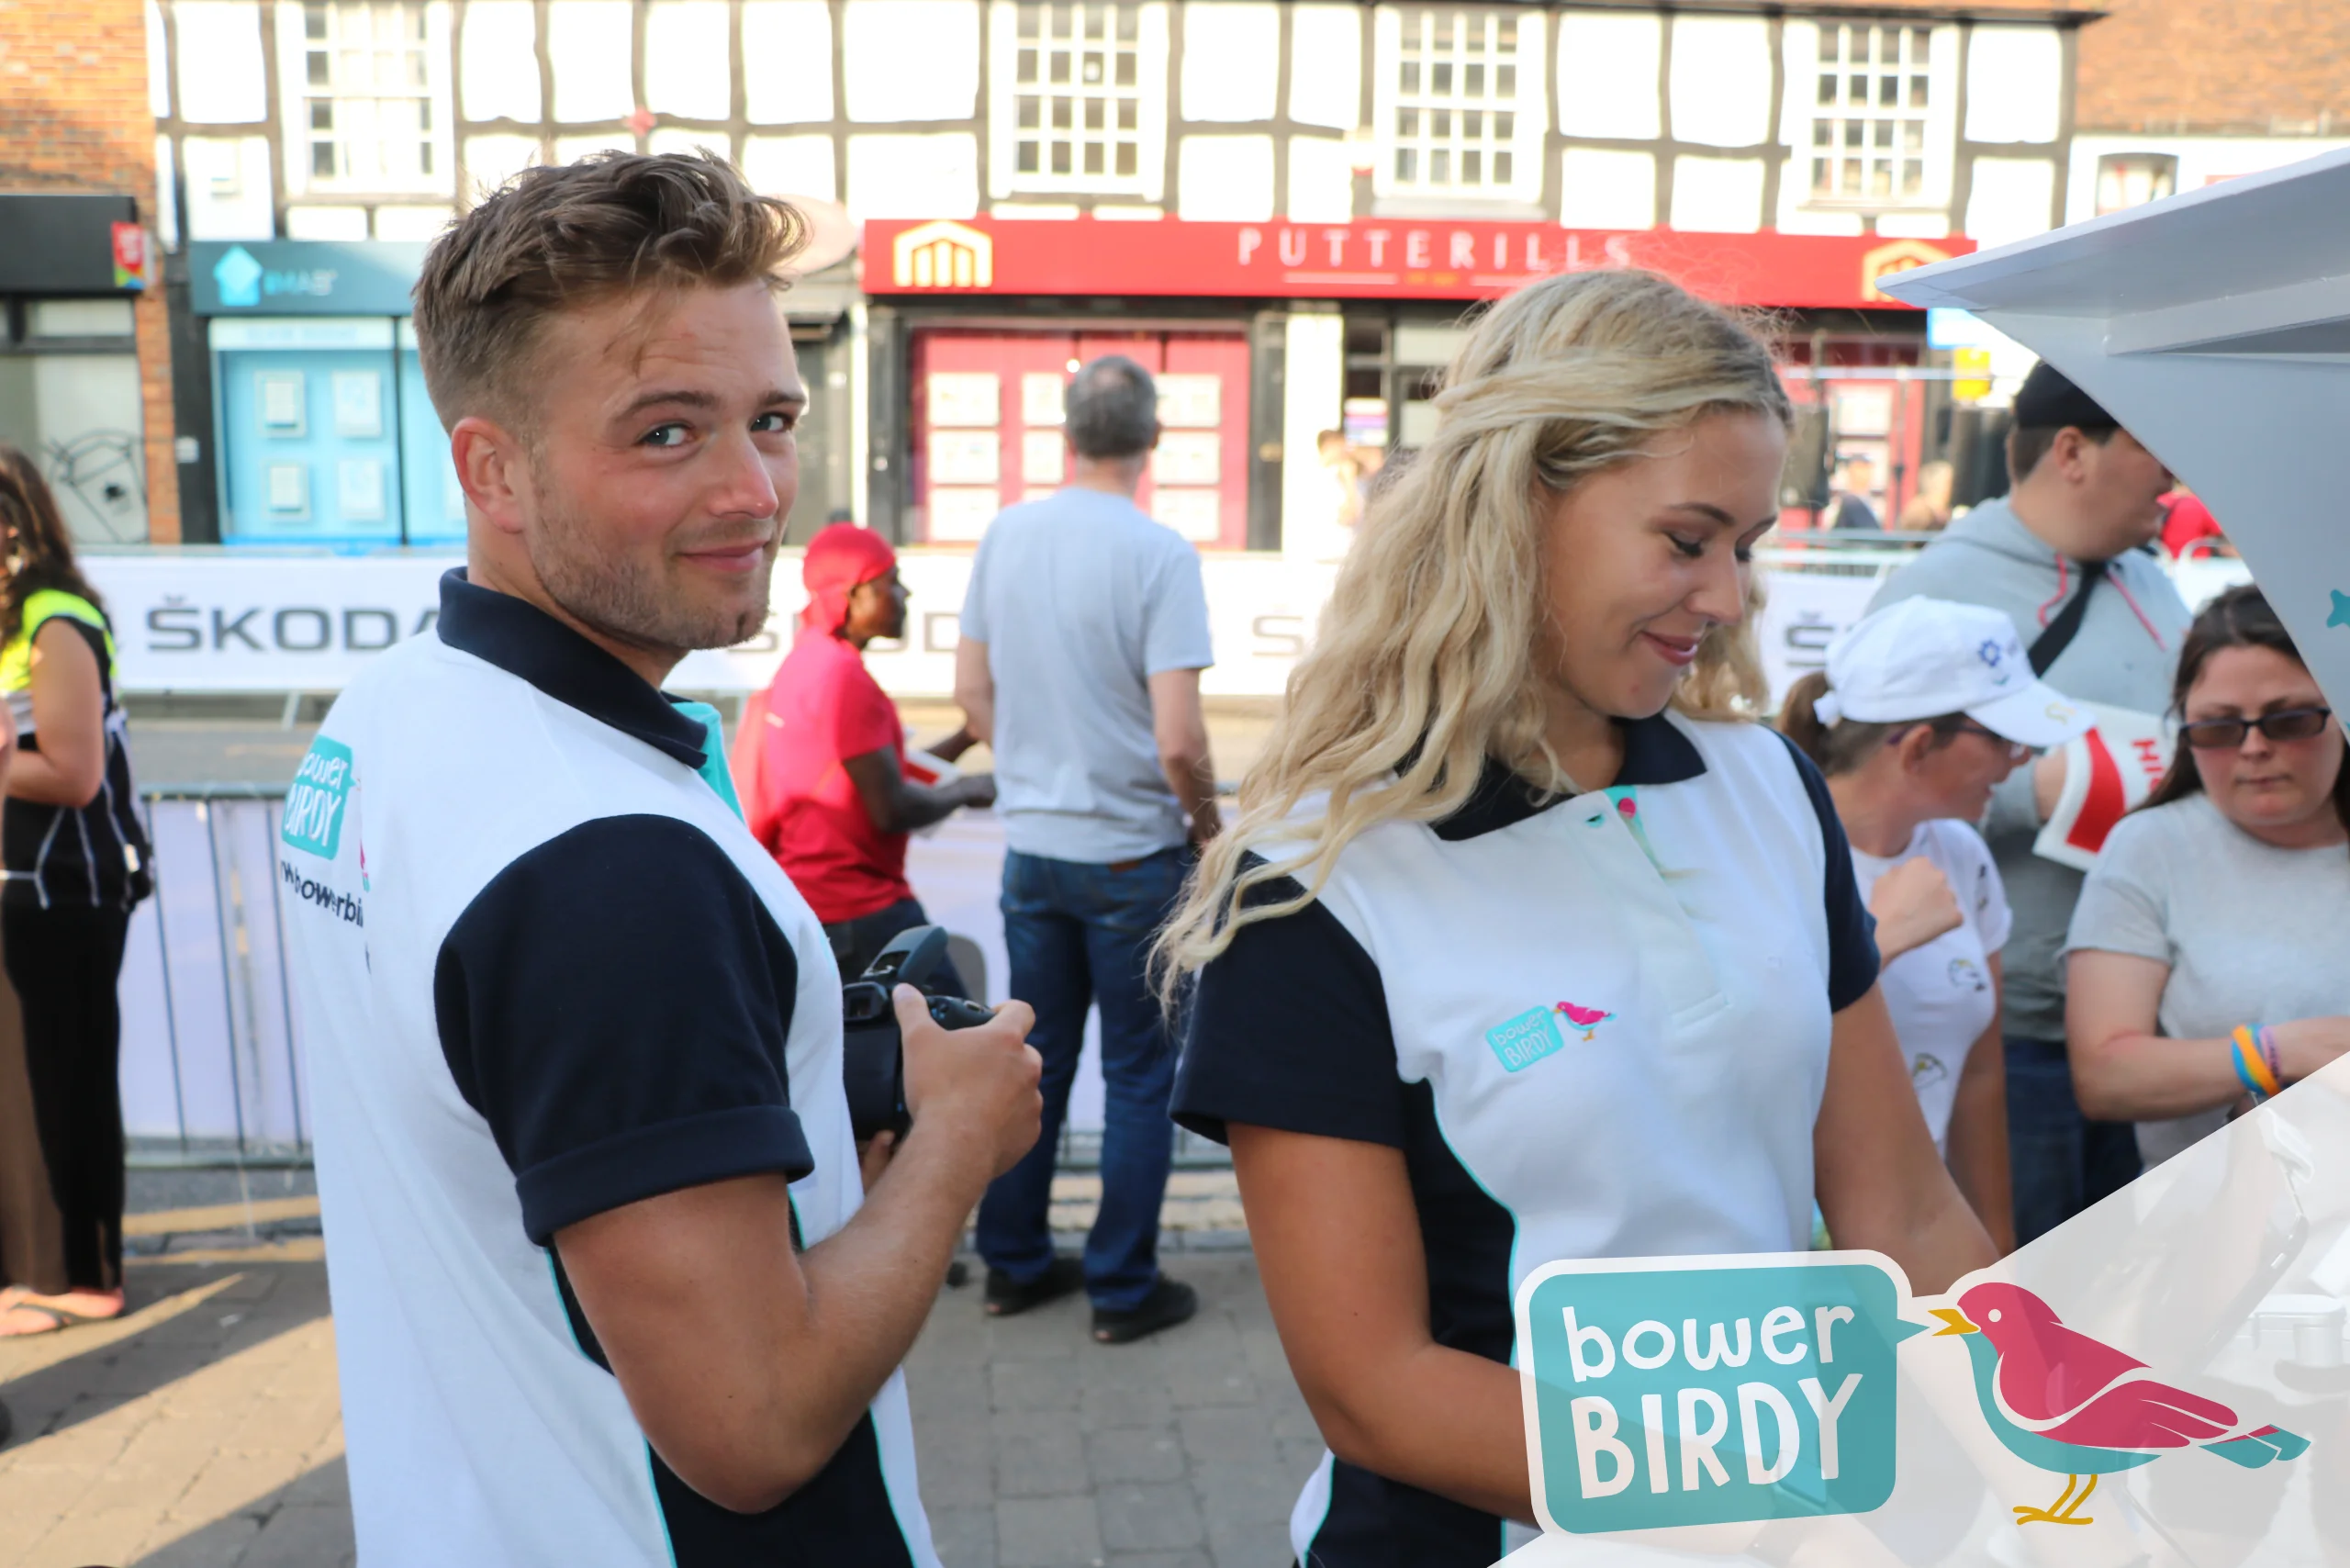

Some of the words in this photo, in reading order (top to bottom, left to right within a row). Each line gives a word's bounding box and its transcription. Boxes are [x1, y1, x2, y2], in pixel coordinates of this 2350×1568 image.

[1237, 227, 1632, 271] PUTTERILLS
[298, 752, 349, 790] ower
[1492, 1009, 1546, 1047] bower
[1504, 1024, 1554, 1068] BIRDY
